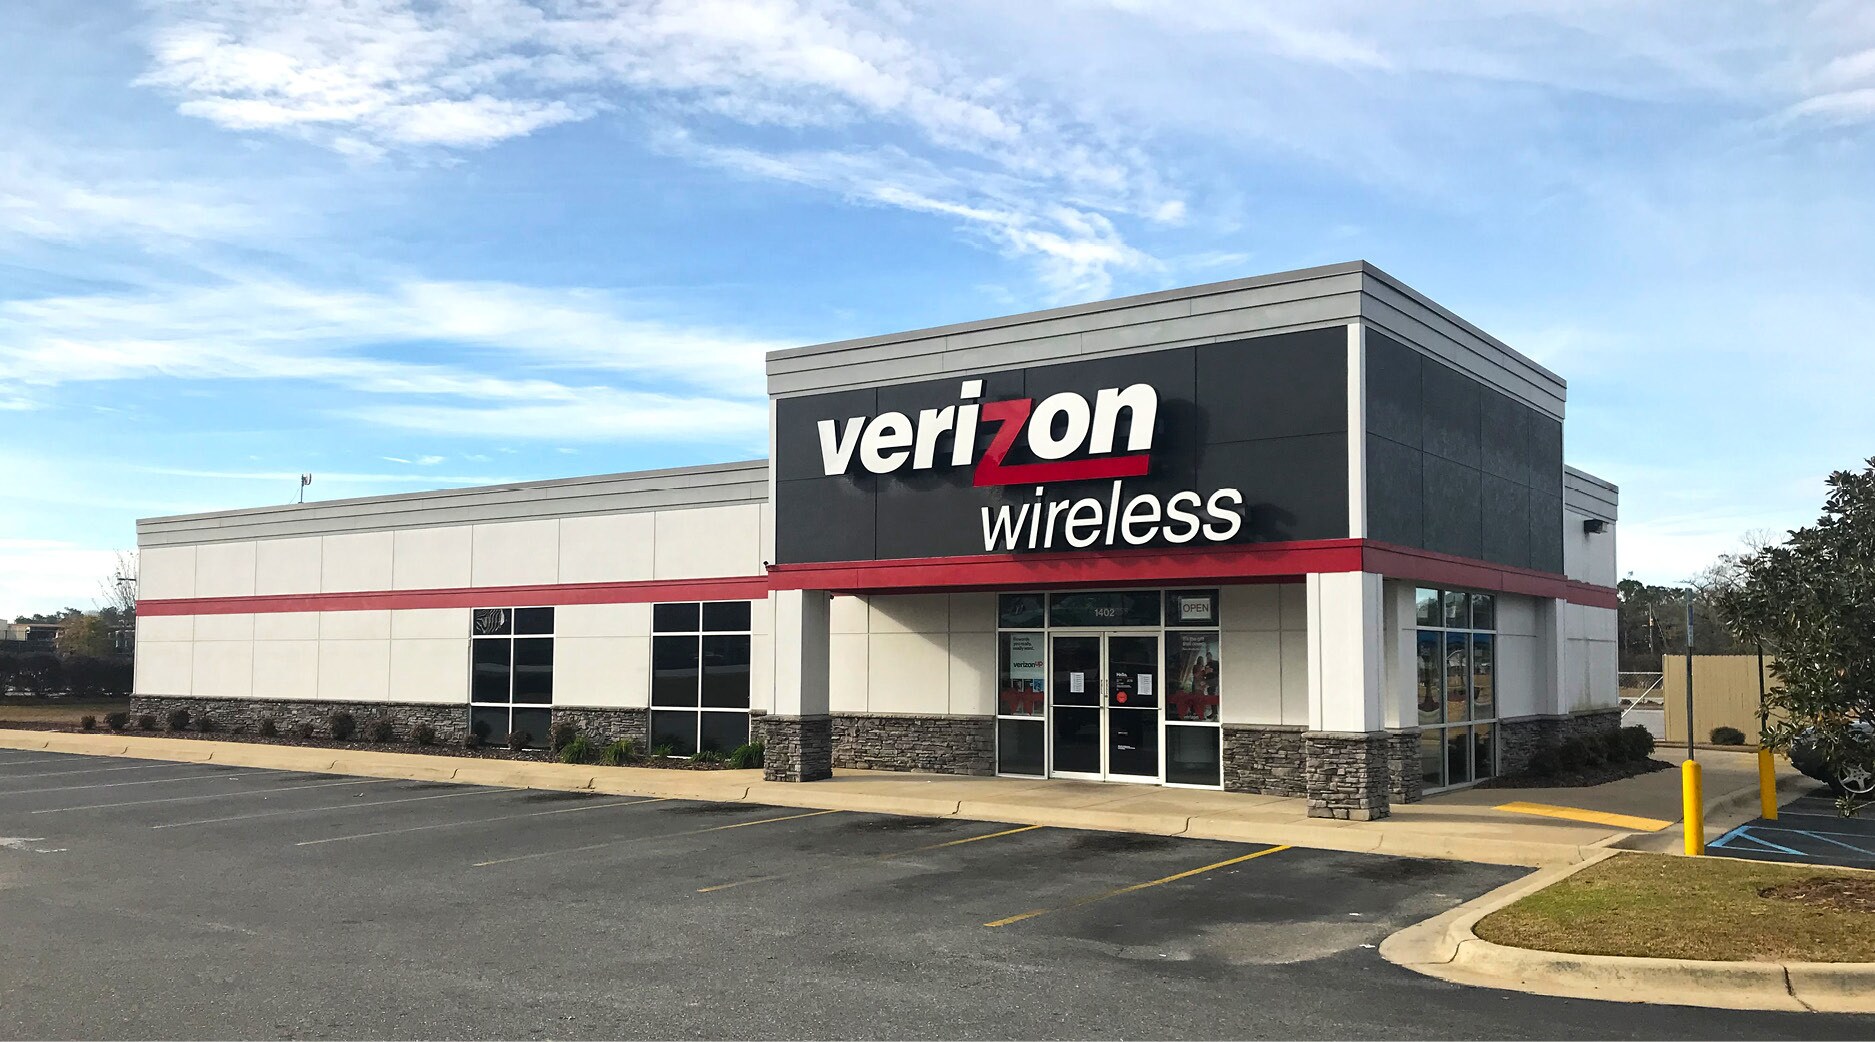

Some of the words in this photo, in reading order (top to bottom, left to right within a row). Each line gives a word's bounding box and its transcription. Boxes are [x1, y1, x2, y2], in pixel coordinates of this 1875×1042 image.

[817, 379, 1158, 487] verizon
[981, 481, 1243, 552] wireless
[1094, 608, 1115, 617] 1402
[1182, 603, 1209, 613] OPEN
